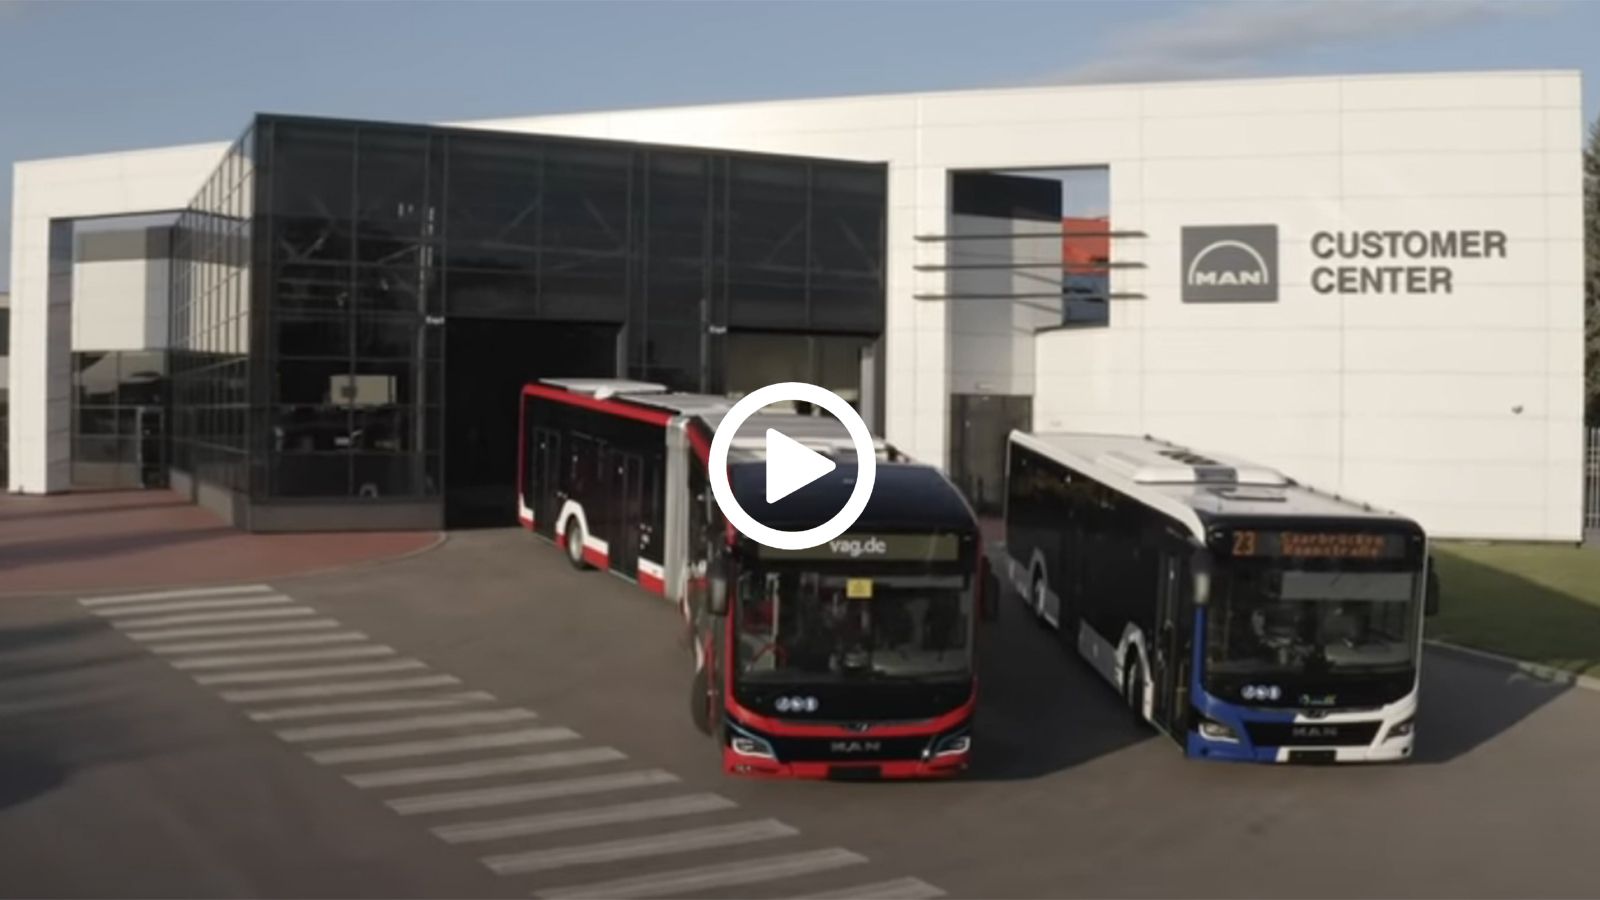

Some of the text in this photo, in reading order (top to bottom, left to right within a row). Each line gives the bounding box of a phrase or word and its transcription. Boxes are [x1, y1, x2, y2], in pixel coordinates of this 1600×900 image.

[1310, 230, 1508, 259] CUSTOMER
[1196, 270, 1261, 286] MAN
[1310, 266, 1453, 295] CENTER
[830, 535, 887, 558] vag.de
[1232, 530, 1257, 557] 23
[1291, 726, 1339, 737] MAN
[831, 741, 881, 752] MAN
